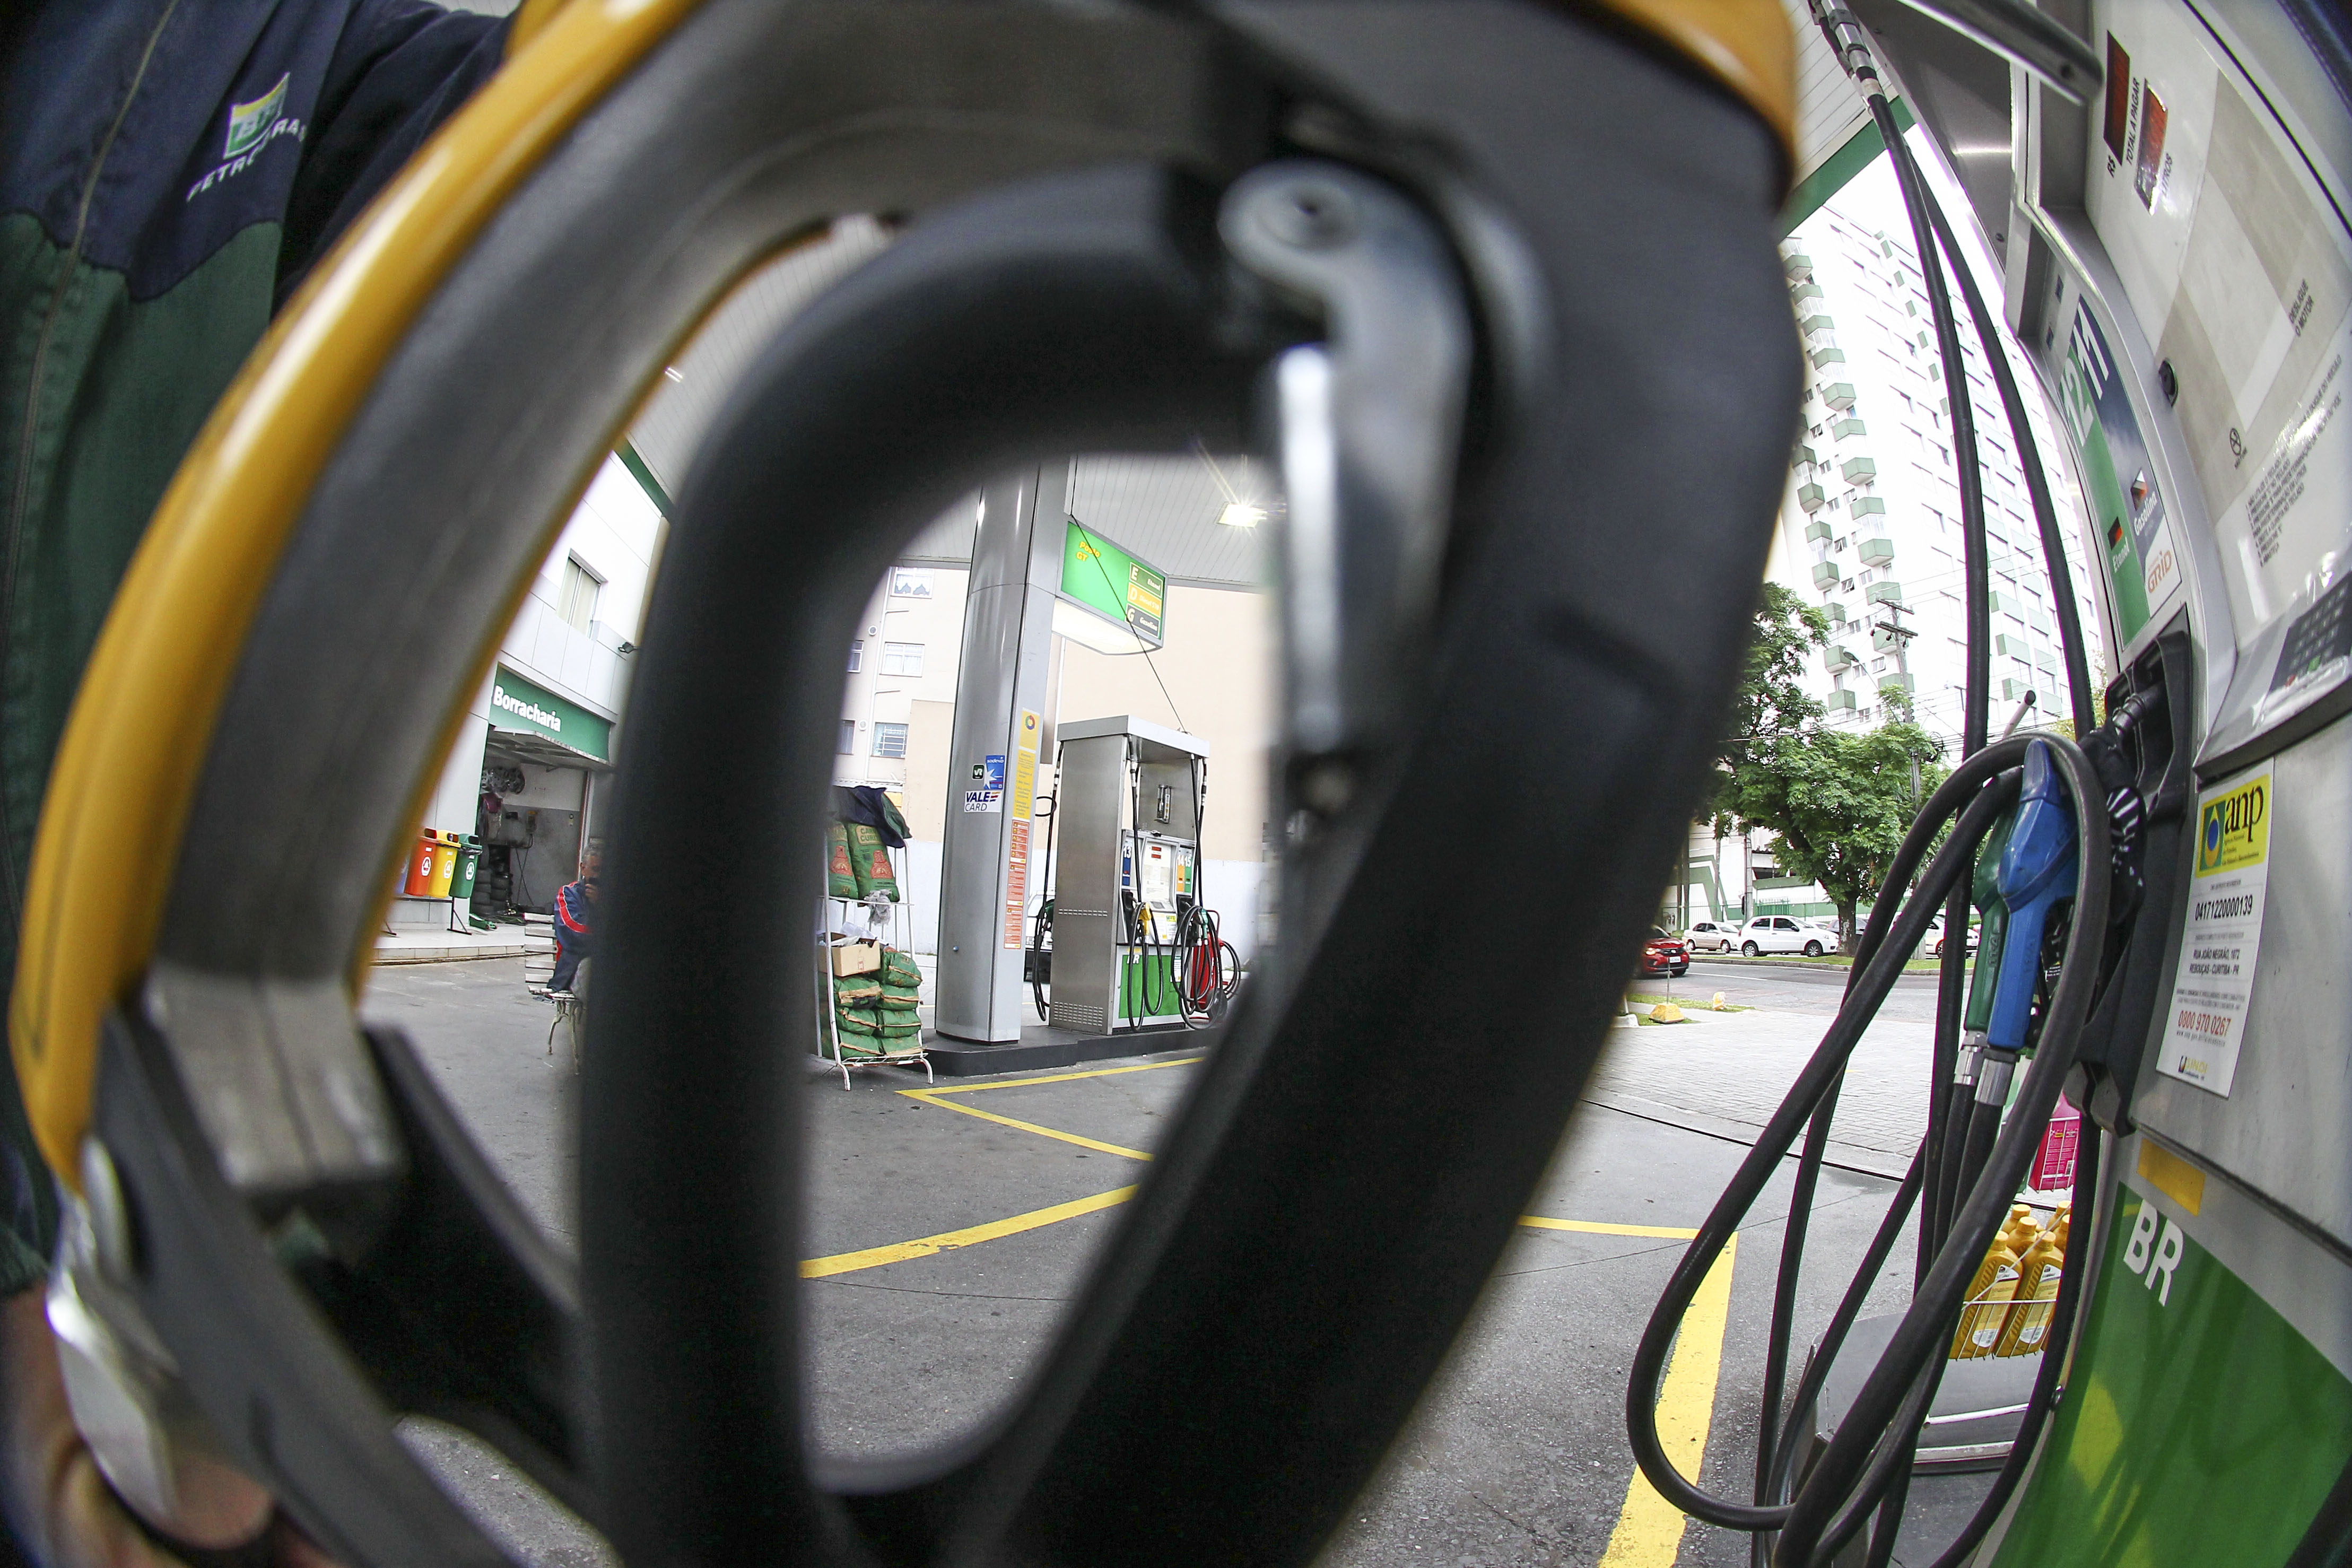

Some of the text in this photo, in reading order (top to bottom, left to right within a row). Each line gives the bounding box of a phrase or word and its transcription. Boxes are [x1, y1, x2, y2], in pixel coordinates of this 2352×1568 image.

[2126, 77, 2140, 166] TOTAL A PAGAR
[2107, 154, 2116, 179] R$
[2162, 152, 2173, 197] LITROS
[2072, 302, 2109, 400] 11
[2133, 491, 2158, 536] Gasolina
[1076, 552, 1088, 561] GT
[1079, 541, 1101, 557] Posto
[2112, 536, 2130, 574] Etanol
[1131, 567, 1139, 581] E
[1130, 588, 1137, 600] D
[1127, 608, 1135, 622] G
[492, 685, 561, 732] Borracharia
[965, 803, 987, 812] CARD
[966, 792, 991, 803] VALE
[2225, 785, 2264, 842] anp
[1123, 846, 1131, 858] 13
[1177, 855, 1184, 866] 14
[1184, 856, 1191, 867] 15
[2195, 894, 2253, 921] 04171220000139
[2178, 1010, 2232, 1037] 0800 970 0267
[2123, 1198, 2184, 1308] BR
